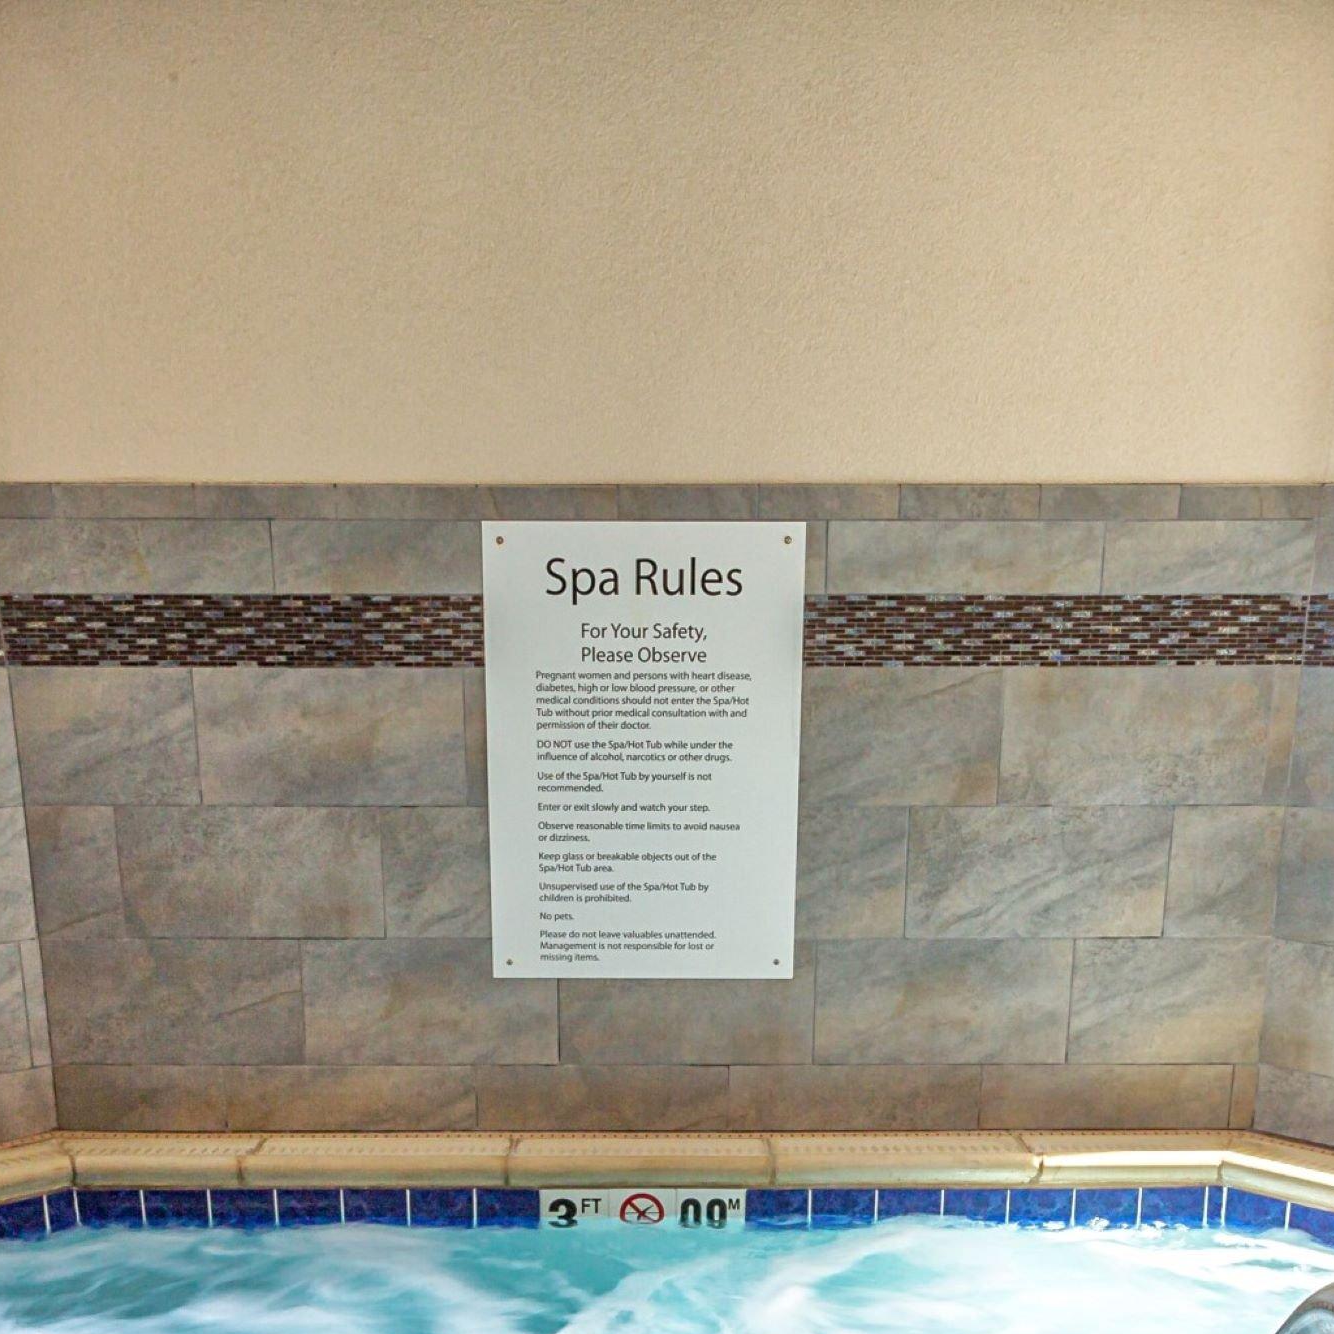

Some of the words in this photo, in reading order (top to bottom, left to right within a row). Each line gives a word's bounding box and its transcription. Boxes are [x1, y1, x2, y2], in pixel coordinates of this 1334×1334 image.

[546, 557, 619, 606] Spa
[634, 557, 742, 596] Rules
[581, 623, 607, 638] For
[611, 623, 647, 640] Your
[653, 622, 707, 643] Safety,
[582, 646, 633, 663] Please
[638, 646, 706, 663] Observe
[536, 670, 576, 682] Pregnant
[614, 670, 631, 680] and
[633, 673, 667, 682] persons
[670, 671, 689, 680] with
[691, 672, 715, 680] heart
[717, 671, 751, 681] disease,
[536, 683, 575, 693] diabetes,
[578, 683, 598, 694] high
[611, 683, 627, 692] low
[630, 683, 655, 692] blood
[657, 686, 697, 694] pressure,
[711, 683, 734, 693] other
[536, 696, 571, 704] medical
[573, 696, 619, 704] conditions
[622, 696, 651, 704] should
[671, 697, 694, 705] enter
[696, 696, 711, 705] the
[713, 696, 749, 707] Spa/Hot
[537, 708, 553, 716] Tub
[555, 708, 589, 717] without
[591, 709, 612, 718] prior
[615, 708, 650, 717] medical
[651, 708, 706, 718] consultation
[709, 708, 728, 717] with
[730, 709, 747, 718] and
[536, 720, 585, 730] permission
[587, 720, 596, 729] of
[598, 720, 618, 730] their
[621, 721, 651, 730] doctor.
[537, 740, 551, 748] DO
[553, 739, 571, 749] NOT
[592, 740, 606, 749] the
[608, 740, 643, 750] Spa/Hot
[646, 740, 662, 749] Tub
[664, 740, 688, 750] while
[690, 740, 715, 749] under
[719, 740, 733, 749] the
[537, 752, 577, 760] influence
[579, 752, 589, 760] of
[591, 752, 624, 762] alcohol,
[626, 753, 665, 762] narcotics
[668, 754, 677, 762] or
[679, 752, 702, 762] other
[704, 753, 731, 764] drugs.
[537, 772, 553, 780] Use
[556, 771, 564, 780] of
[566, 772, 581, 780] the
[583, 772, 618, 782] Spa/Hot
[621, 772, 637, 780] Tub
[639, 772, 649, 782] by
[651, 772, 686, 782] yourself
[688, 772, 694, 780] is
[538, 783, 603, 792] recommended.
[538, 802, 560, 811] Enter
[574, 803, 589, 811] exit
[592, 803, 619, 813] slowly
[621, 803, 637, 811] and
[640, 803, 665, 812] watch
[668, 805, 687, 814] your
[690, 804, 710, 813] step.
[538, 821, 573, 830] Observe
[577, 821, 623, 830] reasonable
[625, 822, 645, 830] time
[647, 822, 670, 830] limits
[684, 822, 707, 831] avoid
[549, 833, 590, 842] dizziness.
[539, 852, 560, 862] Keep
[562, 851, 583, 862] glass
[597, 852, 639, 861] breakable
[641, 852, 672, 862] objects
[691, 853, 700, 861] of
[702, 853, 716, 861] the
[539, 863, 573, 874] Spa/Hot
[576, 864, 591, 872] Tub
[539, 882, 598, 892] Unsupervised
[617, 882, 625, 891] of
[627, 882, 641, 890] the
[644, 882, 678, 892] Spa/Hot
[681, 882, 696, 891] Tub
[698, 883, 709, 893] by
[539, 894, 574, 902] children
[577, 894, 582, 902] is
[585, 894, 631, 904] prohibited.
[540, 912, 552, 920] No
[554, 914, 574, 922] pets.
[540, 930, 567, 938] Please
[569, 930, 580, 938] do
[599, 930, 621, 939] leave
[623, 930, 662, 939] valuables
[665, 931, 716, 939] unattended.
[540, 941, 596, 952] Management
[599, 942, 605, 950] is
[624, 942, 672, 951] responsible
[674, 941, 685, 950] for
[688, 942, 703, 950] lost
[540, 952, 573, 962] missing
[575, 953, 600, 961] items.
[728, 1198, 741, 1210] M
[548, 1198, 578, 1228] 3
[582, 1199, 602, 1213] FT
